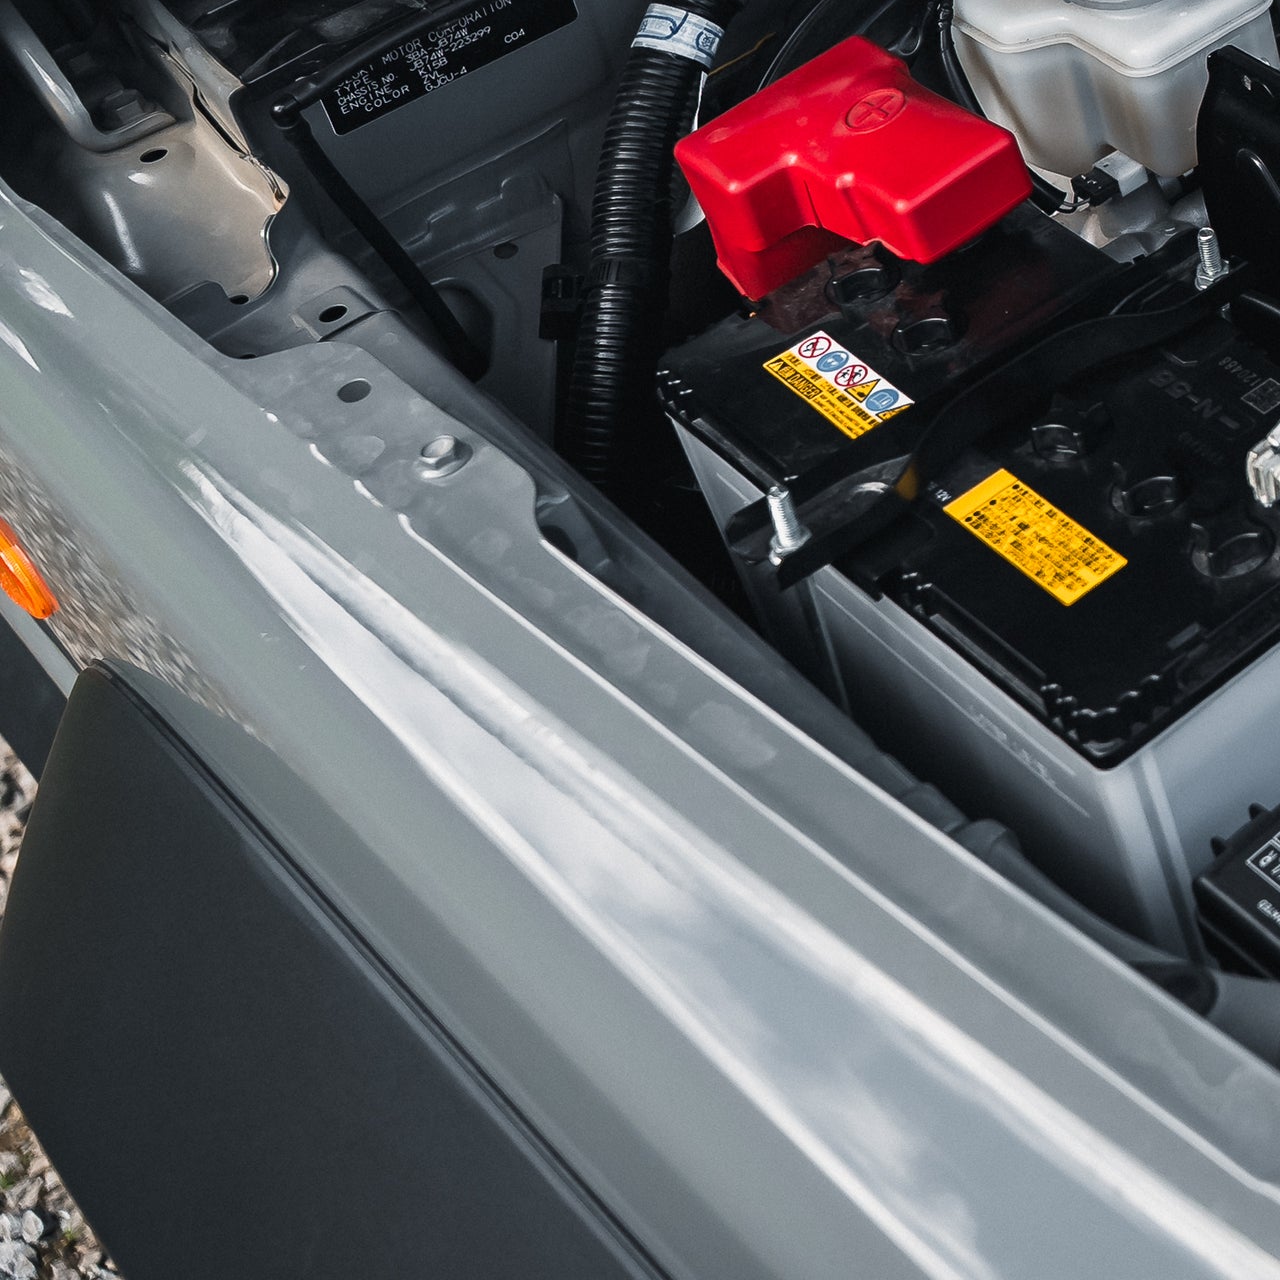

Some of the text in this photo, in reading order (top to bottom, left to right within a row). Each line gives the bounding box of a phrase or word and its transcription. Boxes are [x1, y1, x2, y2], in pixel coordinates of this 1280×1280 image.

[334, 27, 468, 97] TYPE 3BA-JB74W
[338, 80, 379, 106] CHASSIS
[409, 25, 491, 72] JB74W-223299
[381, 38, 423, 65] MOTOR
[340, 56, 448, 115] ENGINE K15B
[364, 84, 410, 112] COLOR
[789, 372, 820, 399] DANGER
[1258, 849, 1279, 868] R
